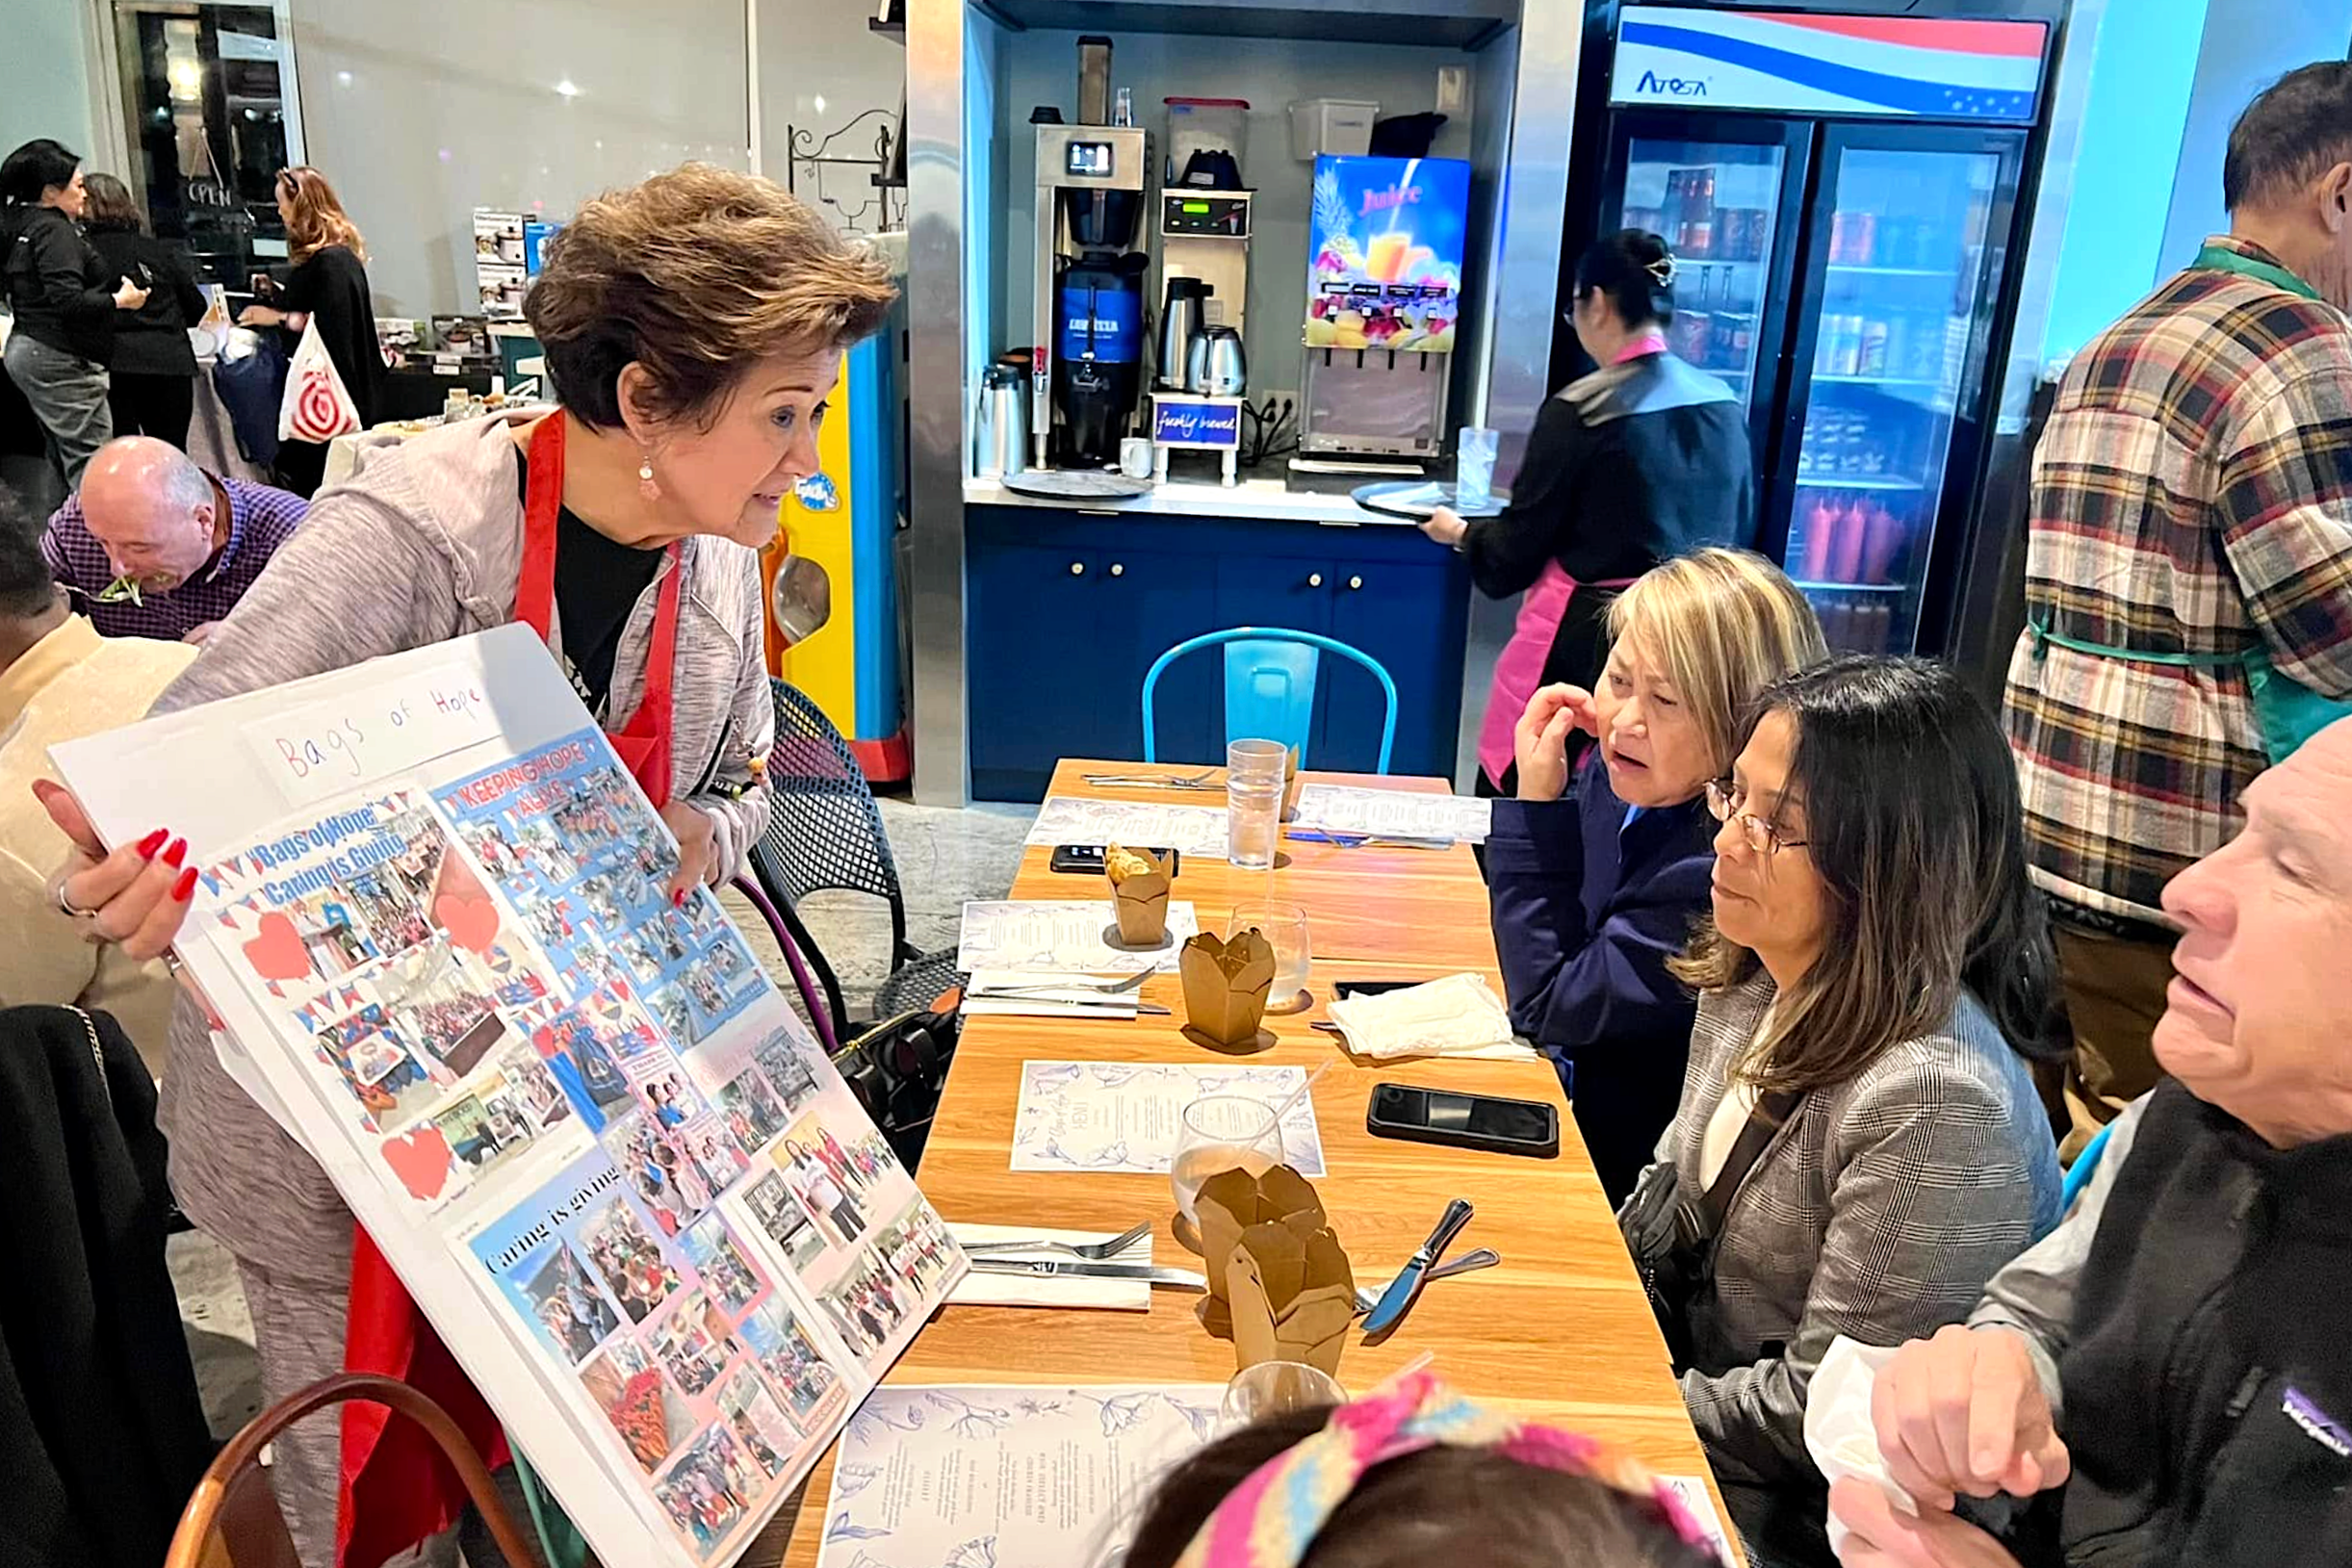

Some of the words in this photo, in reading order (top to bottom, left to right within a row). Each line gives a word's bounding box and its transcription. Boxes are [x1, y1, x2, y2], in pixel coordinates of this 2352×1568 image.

[276, 718, 364, 777] Bags
[429, 688, 480, 722] Hope
[457, 761, 538, 809] KEEPING
[534, 741, 585, 775] HOPE
[517, 780, 568, 817] ALIVE
[264, 864, 334, 905] Caring
[348, 834, 408, 870] Giving
[485, 1221, 551, 1274] Caring
[547, 1209, 570, 1226] is
[569, 1167, 620, 1216] giving
